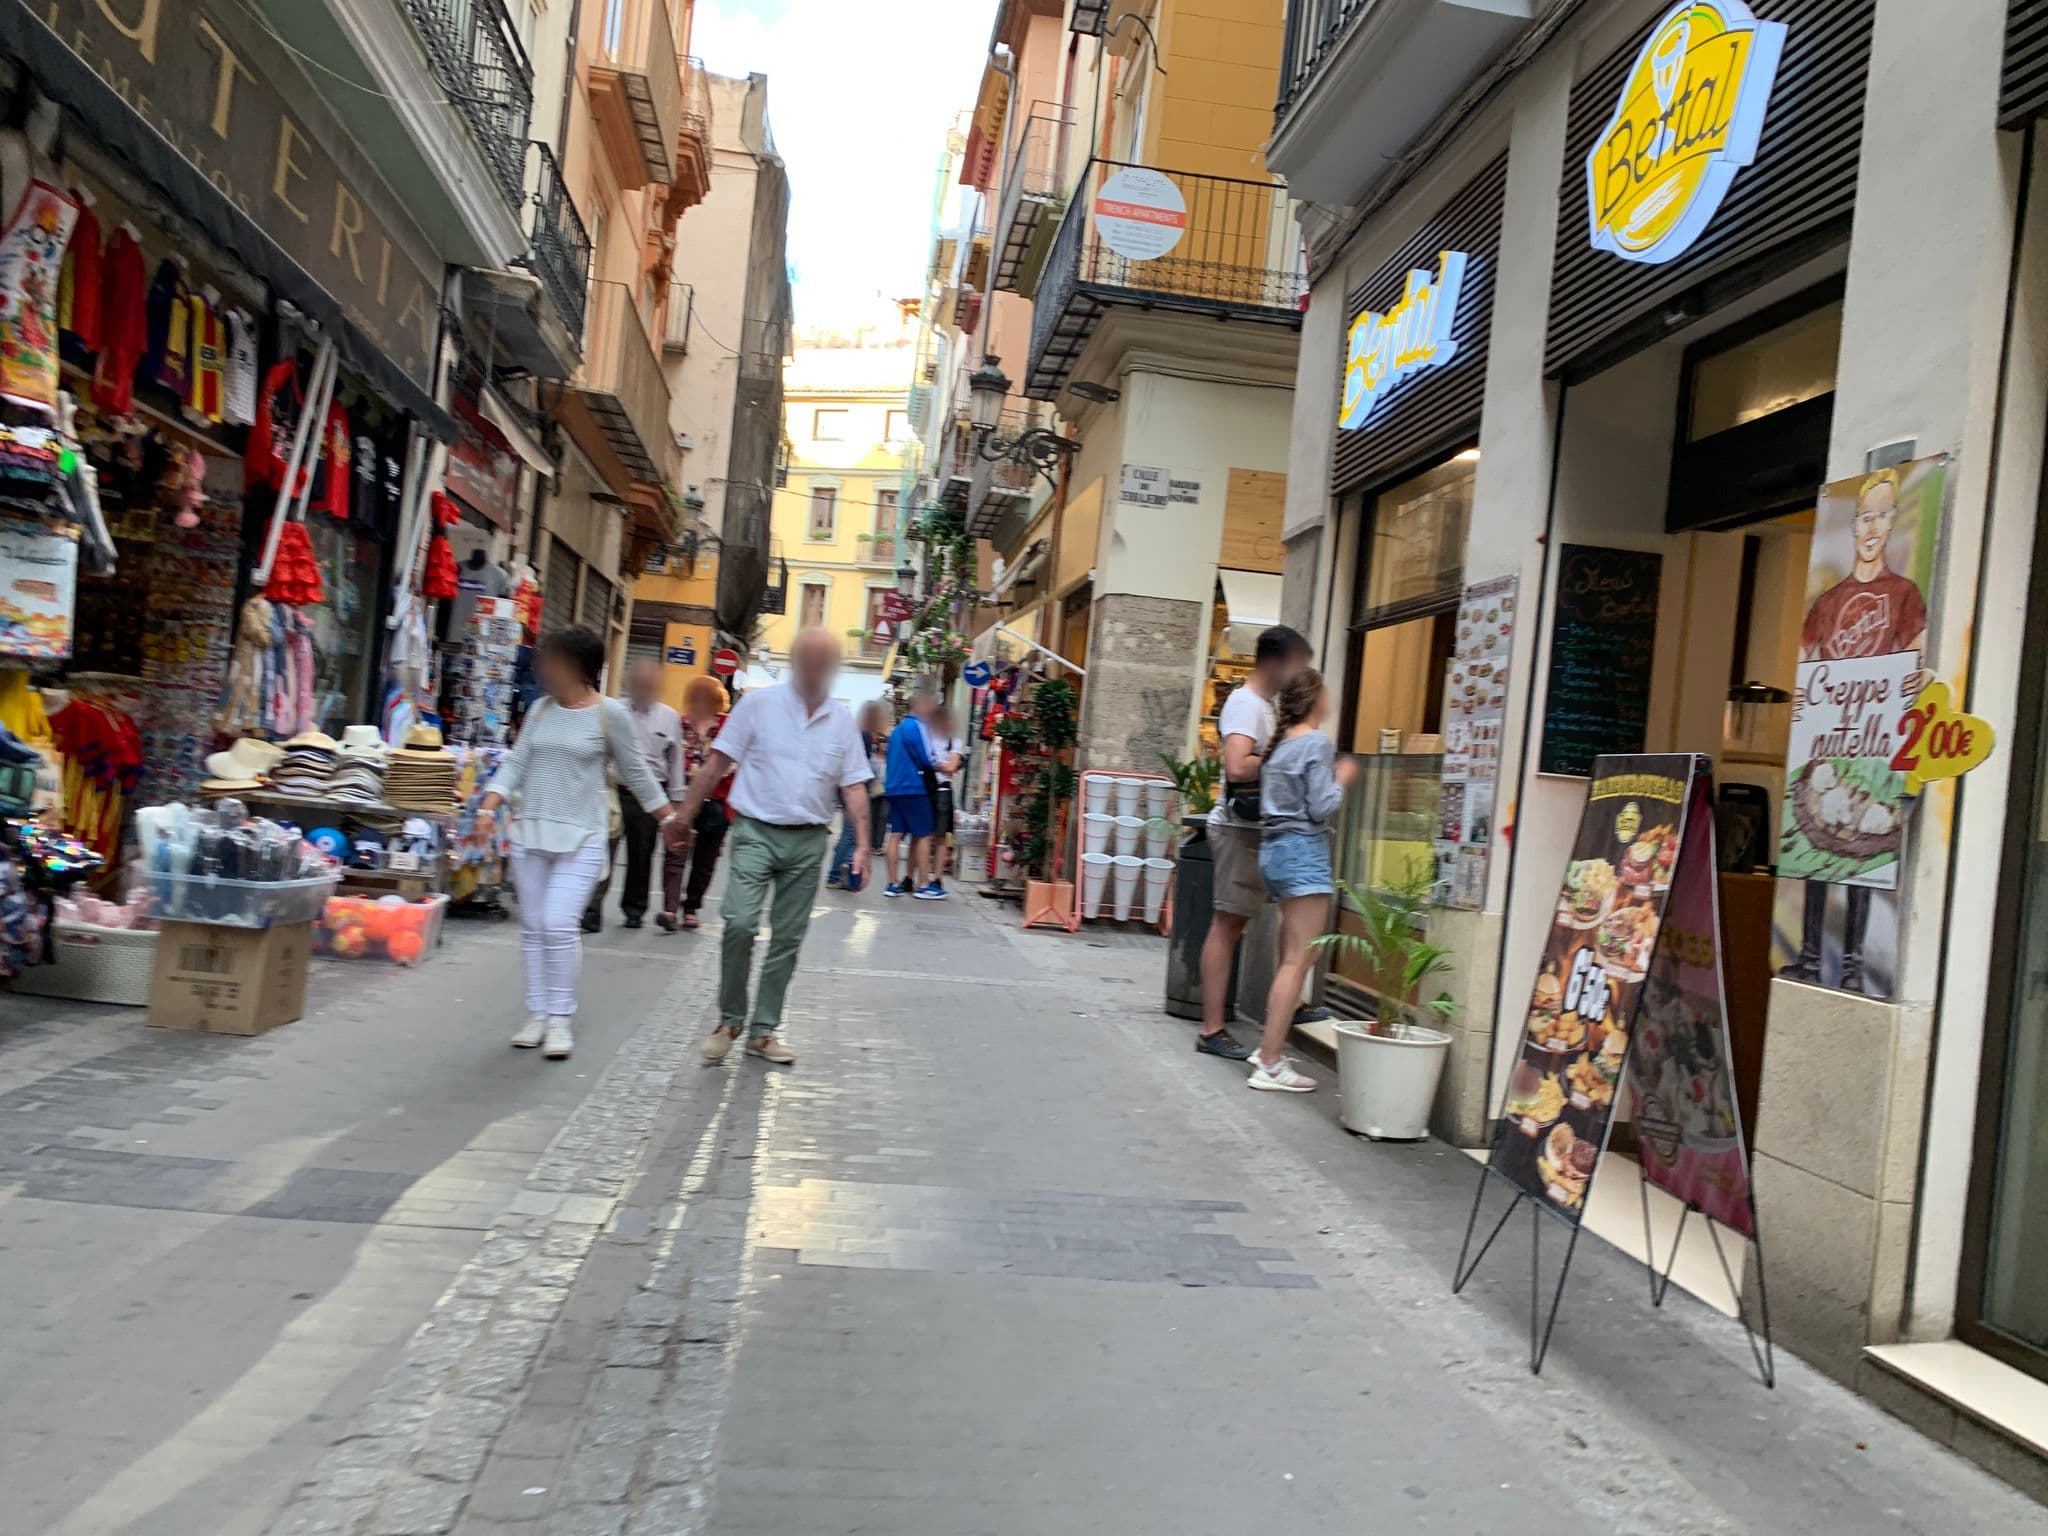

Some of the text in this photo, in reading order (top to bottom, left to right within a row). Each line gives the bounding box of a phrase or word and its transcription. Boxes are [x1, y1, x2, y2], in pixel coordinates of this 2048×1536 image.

[1601, 40, 1738, 219] Bertal
[1339, 250, 1464, 429] Bertal
[1805, 664, 1893, 723] Creppe
[1810, 713, 1893, 759] nutella
